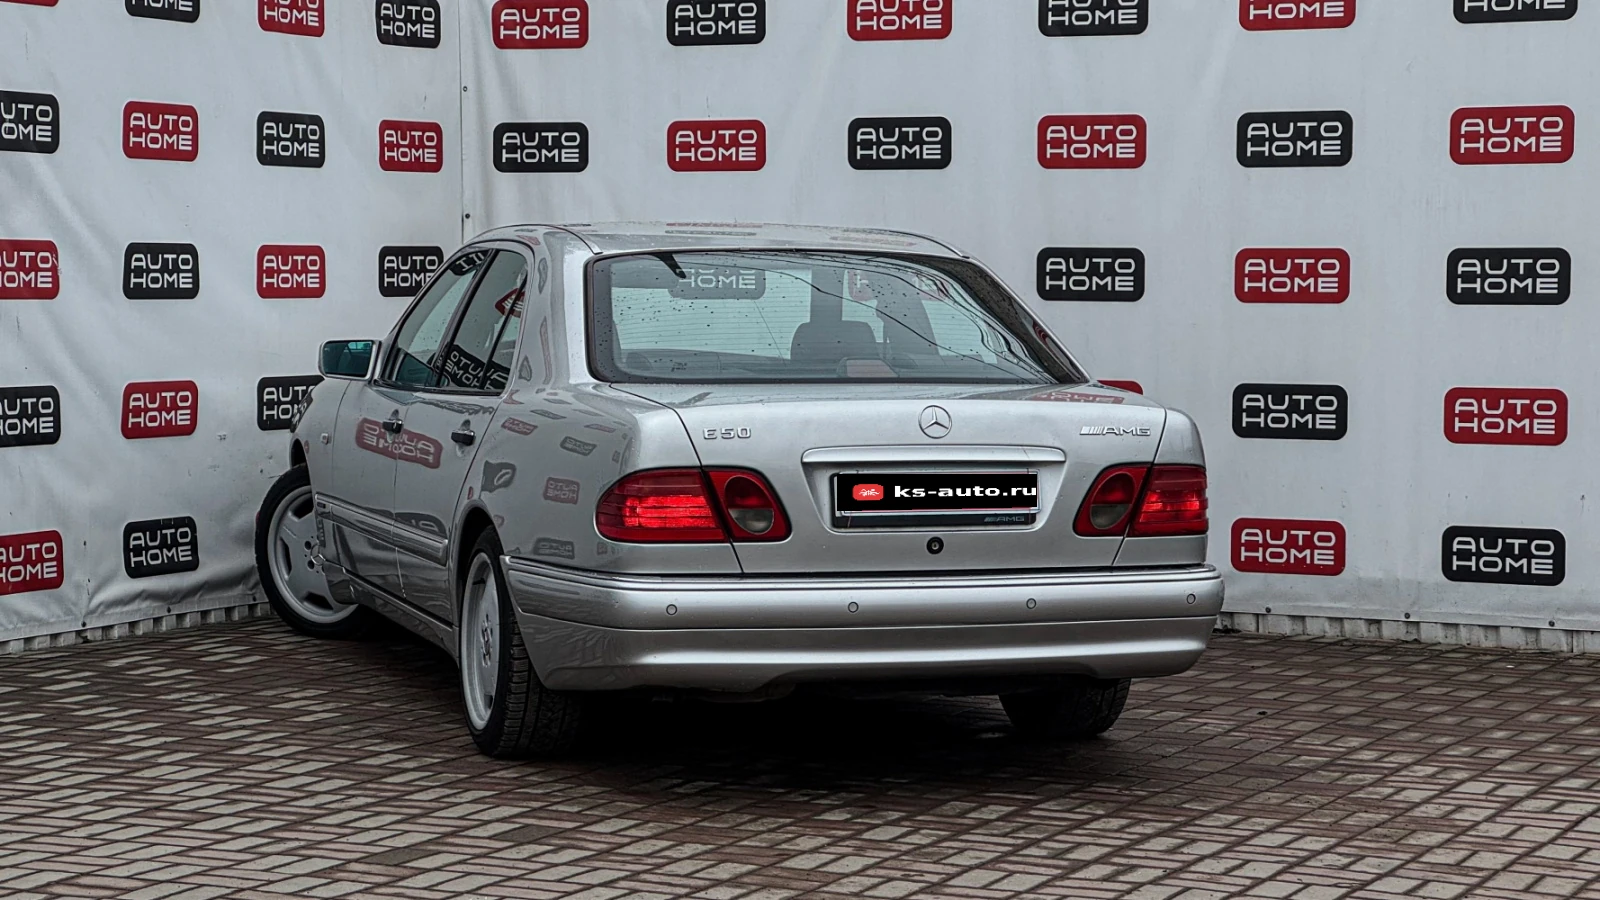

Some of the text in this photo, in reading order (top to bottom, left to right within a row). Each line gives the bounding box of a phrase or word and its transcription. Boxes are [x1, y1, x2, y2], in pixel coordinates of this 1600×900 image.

[381, 3, 435, 21] AUTO
[675, 3, 757, 19] AUTO
[857, 0, 943, 13] AUTO
[1249, 1, 1344, 20] HOME
[264, 5, 319, 26] HOME
[500, 8, 580, 22] AUTO
[857, 14, 942, 31] HOME
[1048, 9, 1137, 26] HOME
[381, 20, 435, 38] HOME
[500, 24, 579, 39] HOME
[675, 20, 756, 36] HOME
[1, 102, 52, 122] UTO
[130, 113, 193, 131] AUTO
[1247, 121, 1342, 138] AUTO
[1461, 117, 1563, 134] AUTO
[1, 122, 52, 142] OME
[263, 122, 320, 140] AUTO
[384, 130, 437, 146] AUTO
[502, 132, 580, 146] AUTO
[676, 130, 757, 144] AUTO
[857, 127, 942, 142] AUTO
[1047, 125, 1137, 140] AUTO
[130, 131, 192, 150] HOME
[263, 140, 319, 157] HOME
[1247, 140, 1341, 157] HOME
[1460, 136, 1561, 153] HOME
[385, 147, 436, 162] HOME
[502, 149, 579, 162] HOME
[676, 147, 756, 161] HOME
[857, 145, 941, 159] HOME
[1047, 143, 1135, 158] HOME
[0, 251, 52, 268] UTO
[131, 254, 193, 269] AUTO
[263, 255, 320, 270] AUTO
[384, 256, 439, 270] AUTO
[1046, 258, 1135, 273] AUTO
[1245, 259, 1340, 274] AUTO
[1458, 259, 1560, 274] AUTO
[0, 271, 52, 287] OME
[130, 273, 193, 288] HOME
[263, 273, 319, 288] HOME
[1046, 275, 1134, 291] HOME
[1244, 277, 1338, 292] HOME
[1457, 278, 1558, 293] HOME
[129, 391, 192, 409] AUTO
[264, 386, 315, 402] AUT
[1243, 394, 1337, 410] AUTO
[0, 397, 54, 415] UTO
[1455, 398, 1557, 415] AUTO
[0, 417, 53, 435] OME
[128, 410, 191, 428] HOME
[1242, 412, 1336, 429] HOME
[1455, 417, 1555, 434] HOME
[1101, 426, 1150, 436] AMG
[130, 528, 191, 548] AUTO
[1241, 529, 1335, 546] AUTO
[1453, 537, 1554, 555] AUTO
[130, 546, 192, 567] HOME
[1241, 547, 1334, 565] HOME
[1453, 555, 1553, 574] HOME
